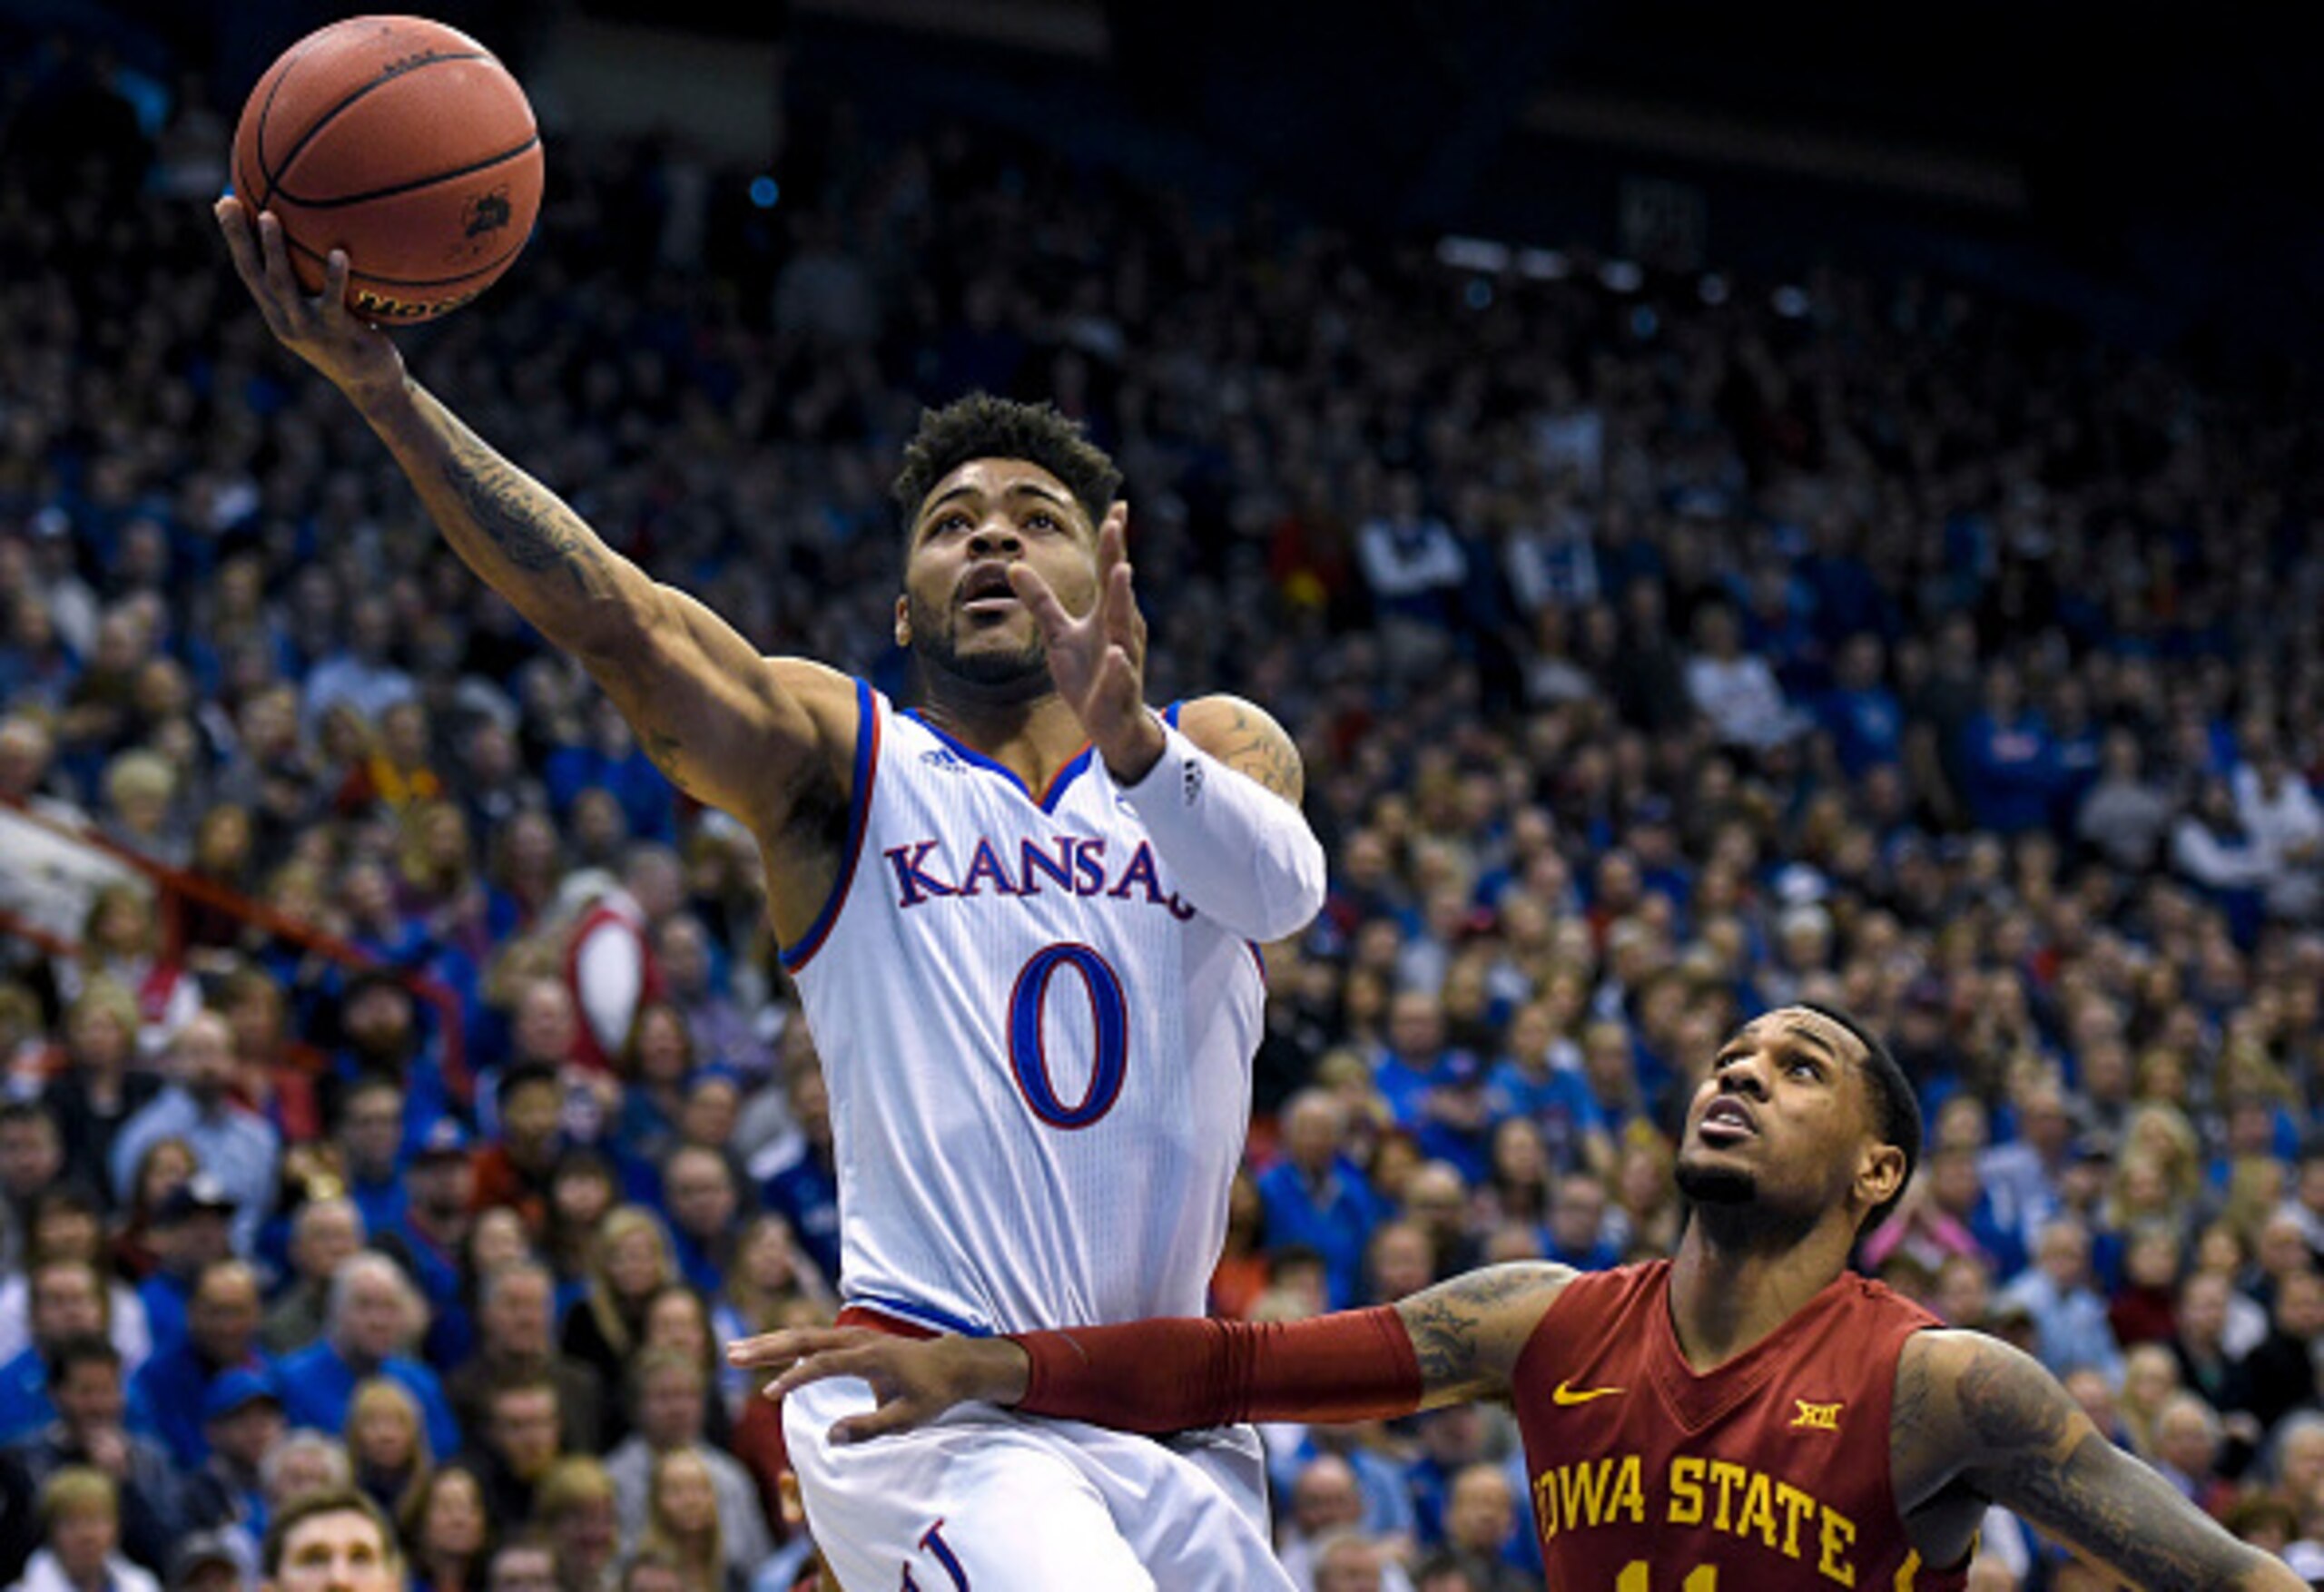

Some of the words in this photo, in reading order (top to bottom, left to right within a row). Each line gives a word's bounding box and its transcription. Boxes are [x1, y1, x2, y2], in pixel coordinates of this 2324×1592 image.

[883, 835, 1197, 921] KANSA
[1006, 941, 1128, 1131] 0
[1666, 1455, 1856, 1588] STATE
